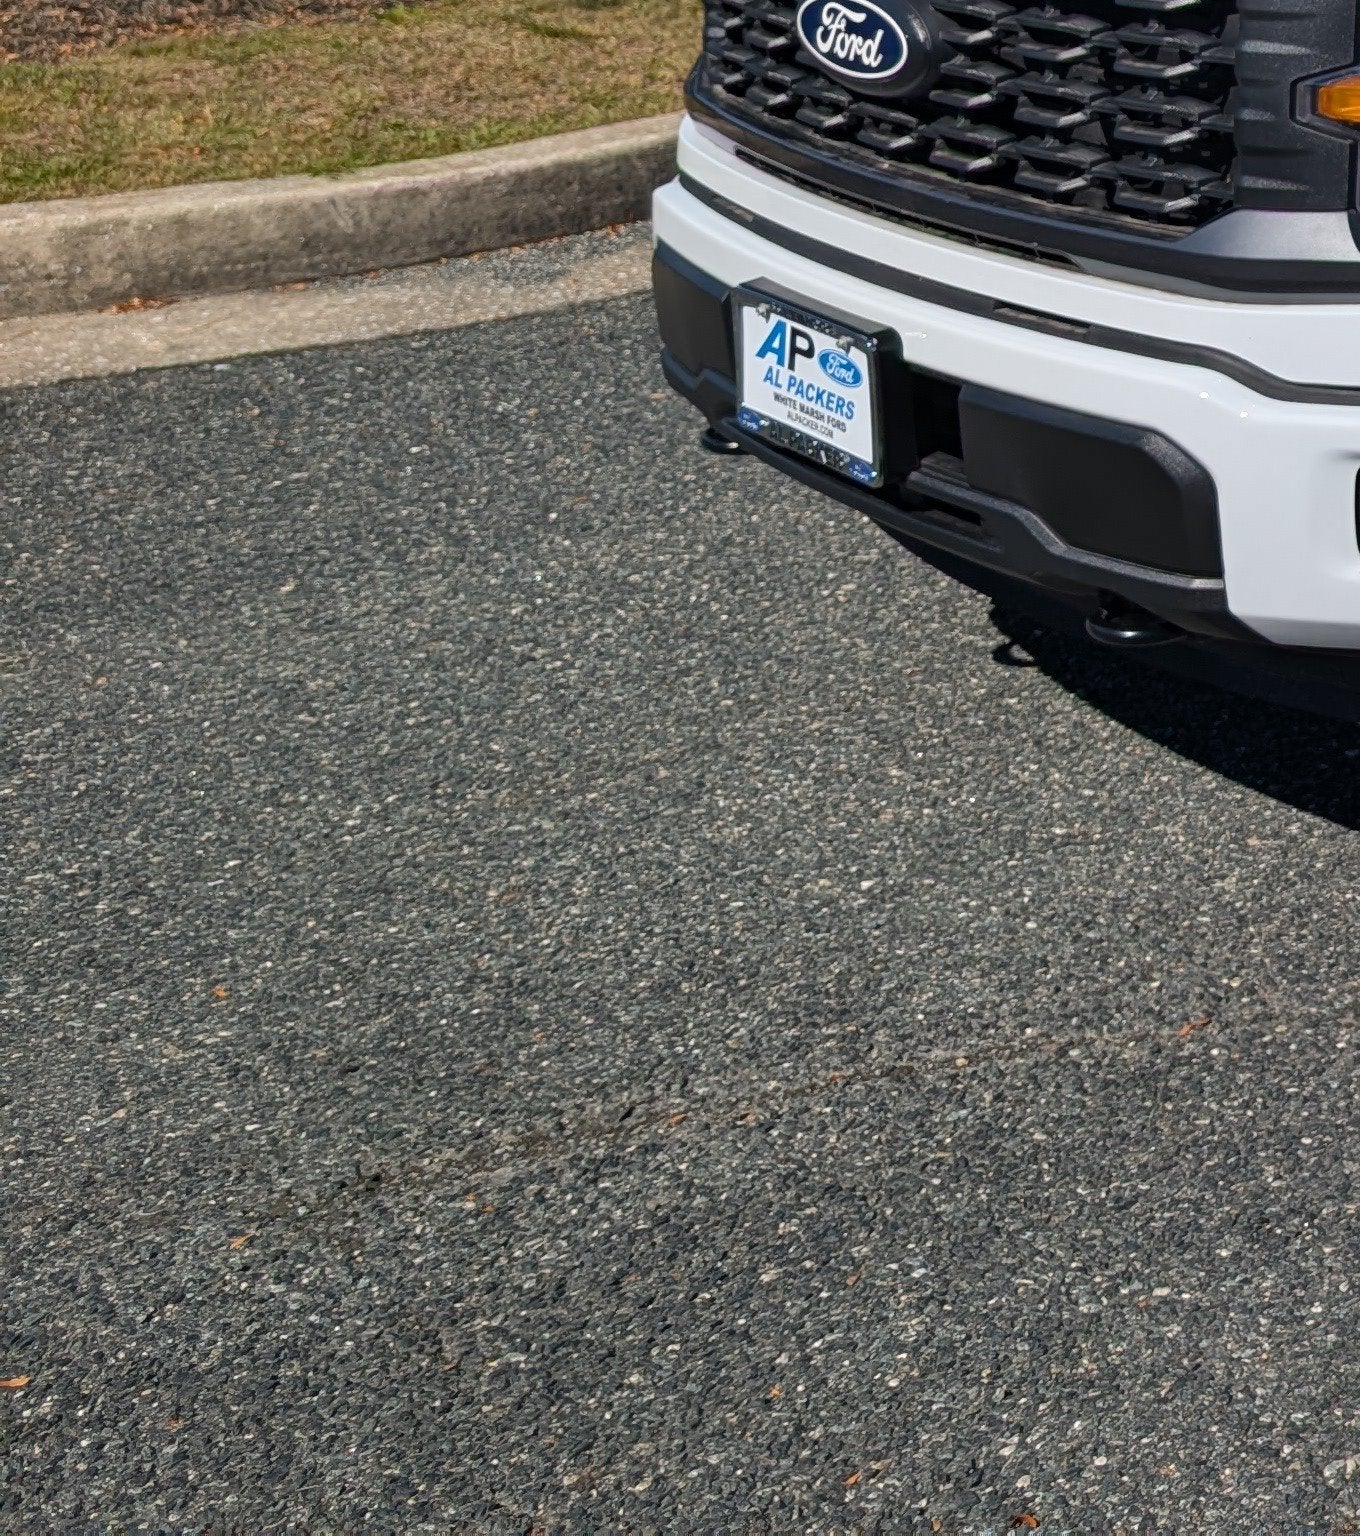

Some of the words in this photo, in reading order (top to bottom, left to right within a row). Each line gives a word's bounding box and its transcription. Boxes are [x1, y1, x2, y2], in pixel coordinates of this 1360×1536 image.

[816, 1, 885, 68] Ford
[755, 319, 815, 372] AP
[825, 353, 856, 384] Ford
[763, 365, 782, 389] AL
[786, 374, 855, 420] PACKERS
[773, 391, 798, 411] WHITE
[827, 414, 847, 433] FORD
